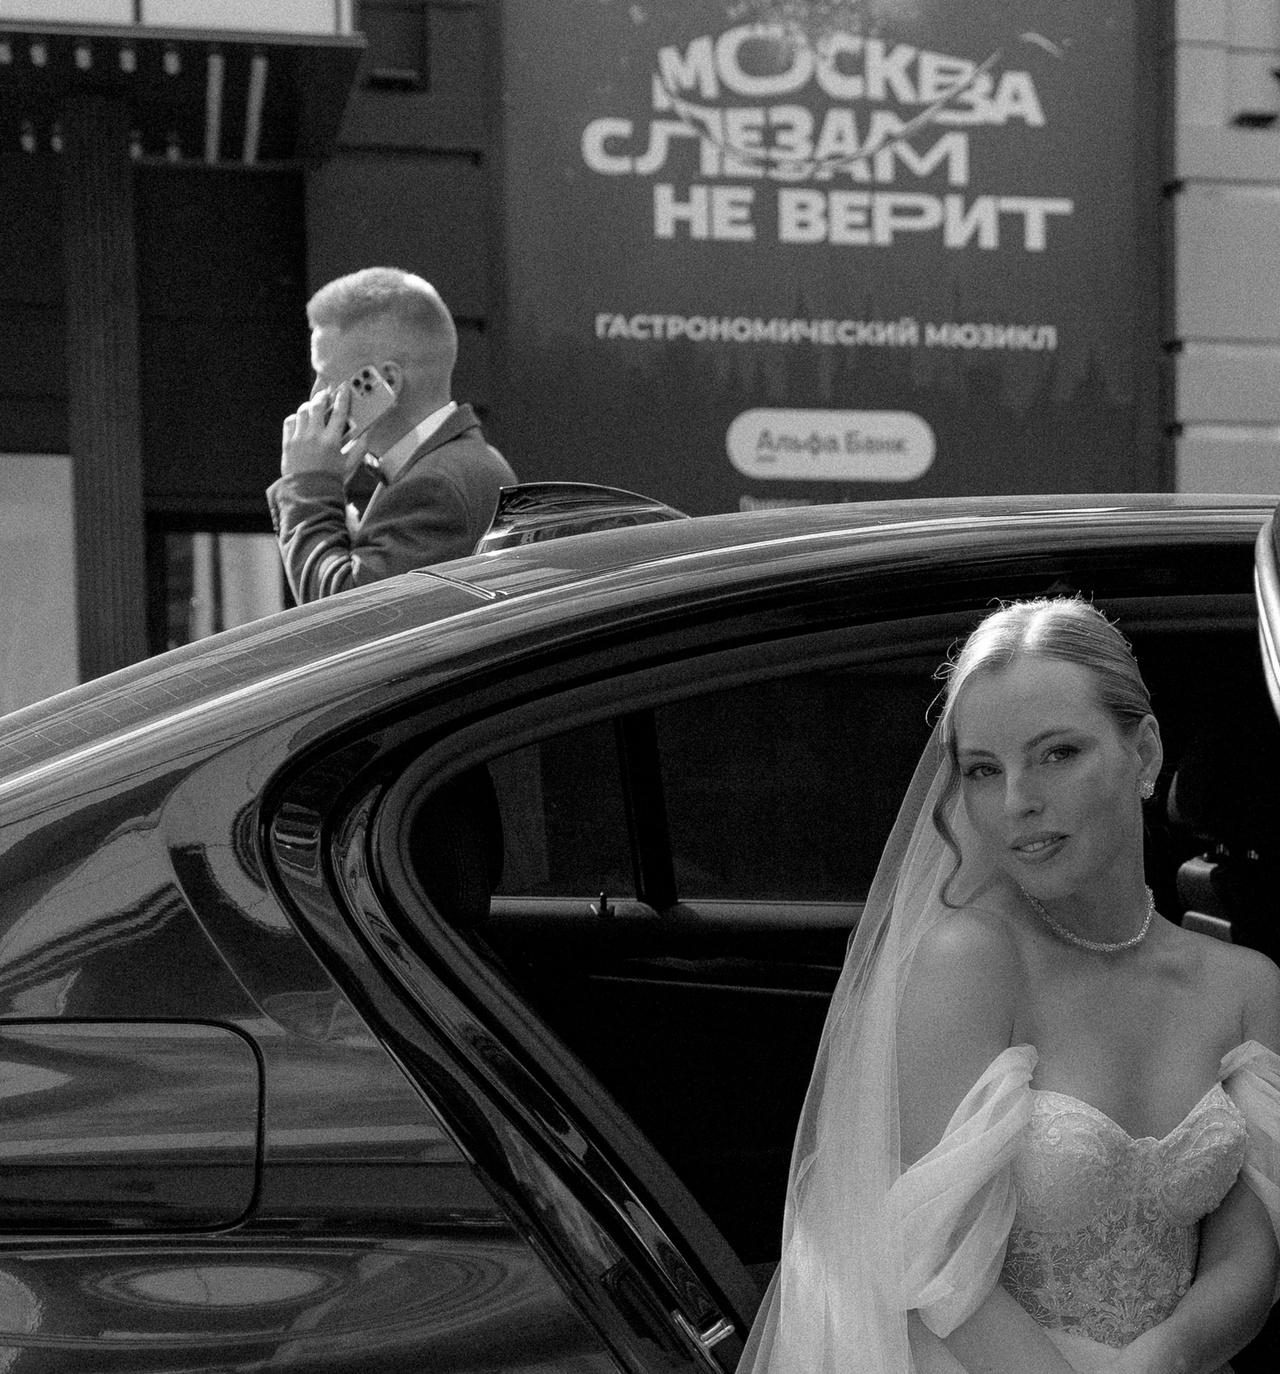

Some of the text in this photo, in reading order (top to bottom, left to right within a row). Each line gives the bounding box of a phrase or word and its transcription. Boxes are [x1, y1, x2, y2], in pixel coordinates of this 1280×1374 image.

[652, 24, 1045, 127] МОСКВА
[581, 104, 970, 186] СЛЕЗАМ
[653, 183, 1073, 251] НЕ ВЕРИТ
[595, 313, 1058, 350] ГАСТРОНОМИЧЕСКИЙ МЮЗИКЛ
